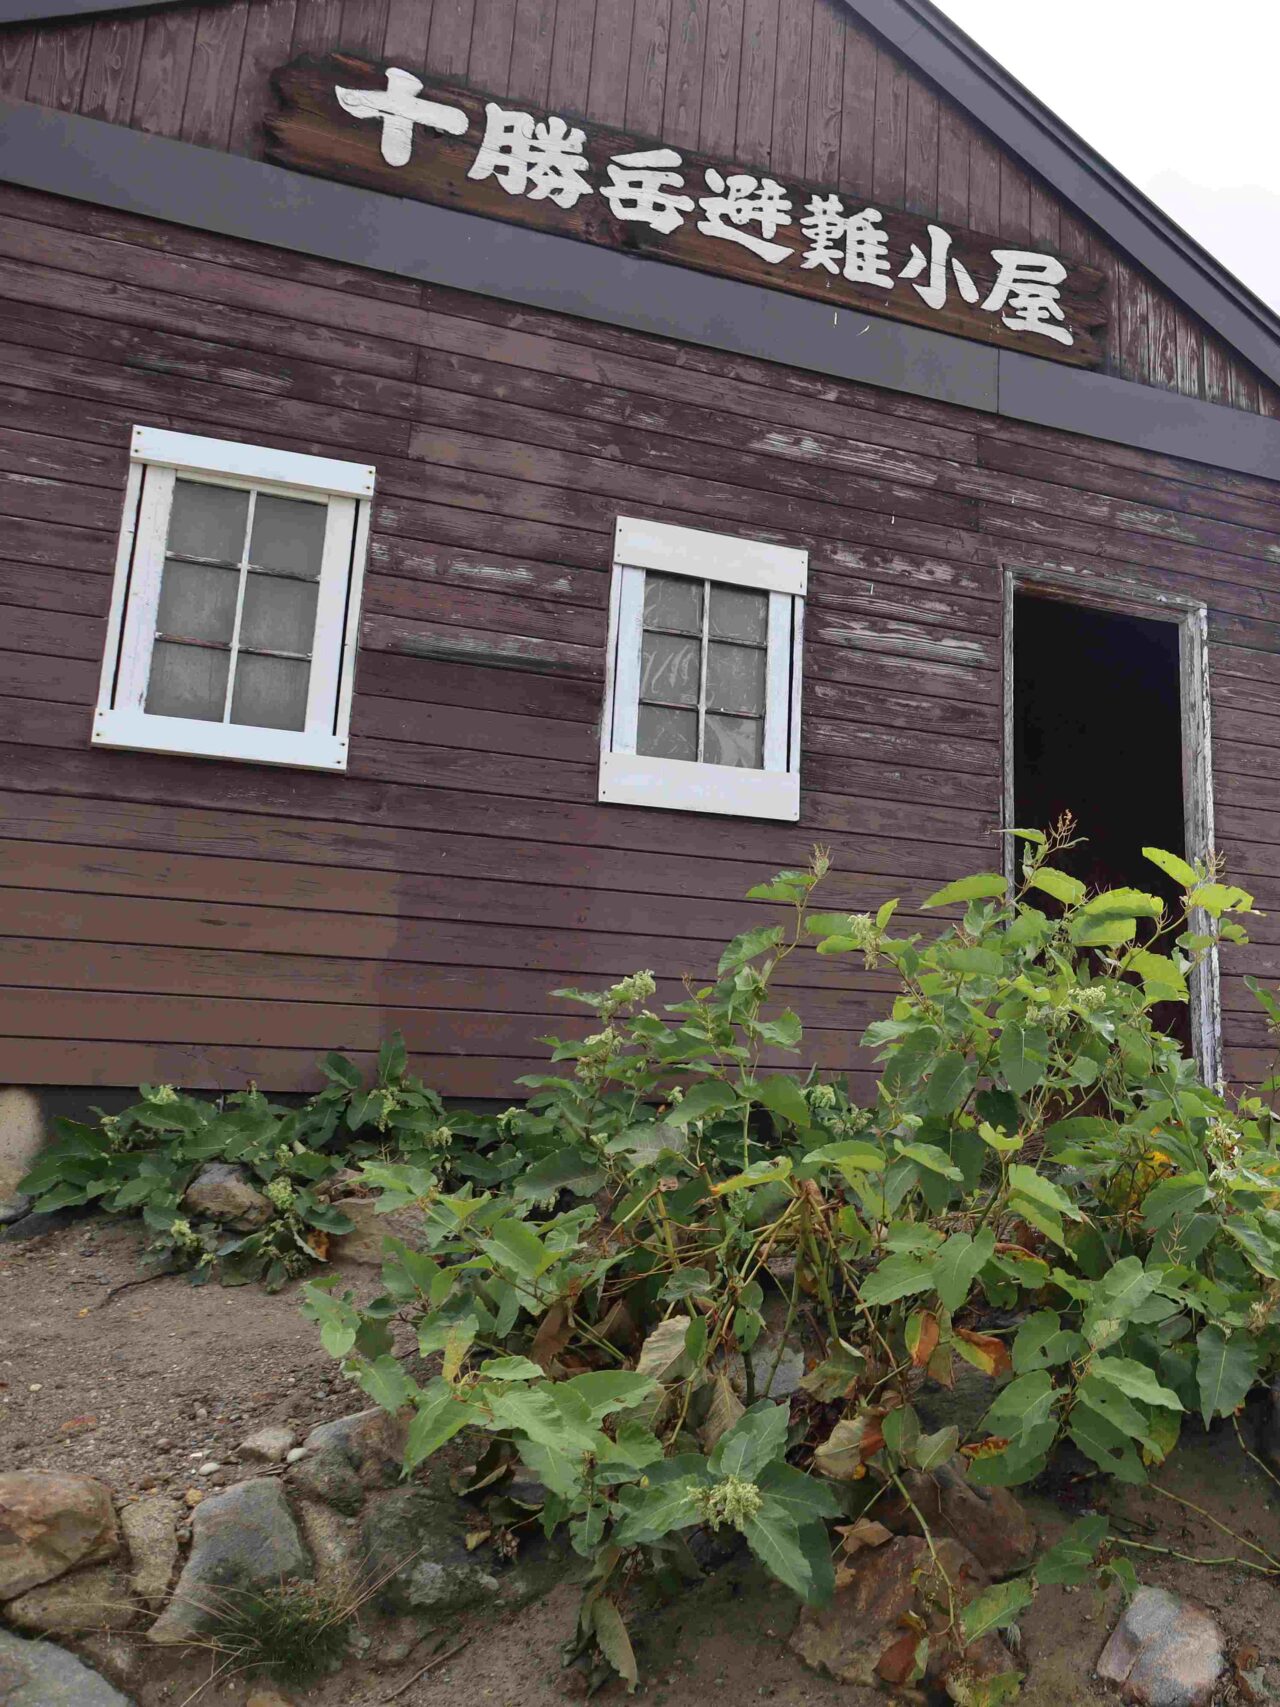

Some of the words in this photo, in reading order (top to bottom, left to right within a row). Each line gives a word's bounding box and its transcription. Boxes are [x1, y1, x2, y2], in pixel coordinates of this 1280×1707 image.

[334, 67, 1075, 346] 十勝岳避難小屋
